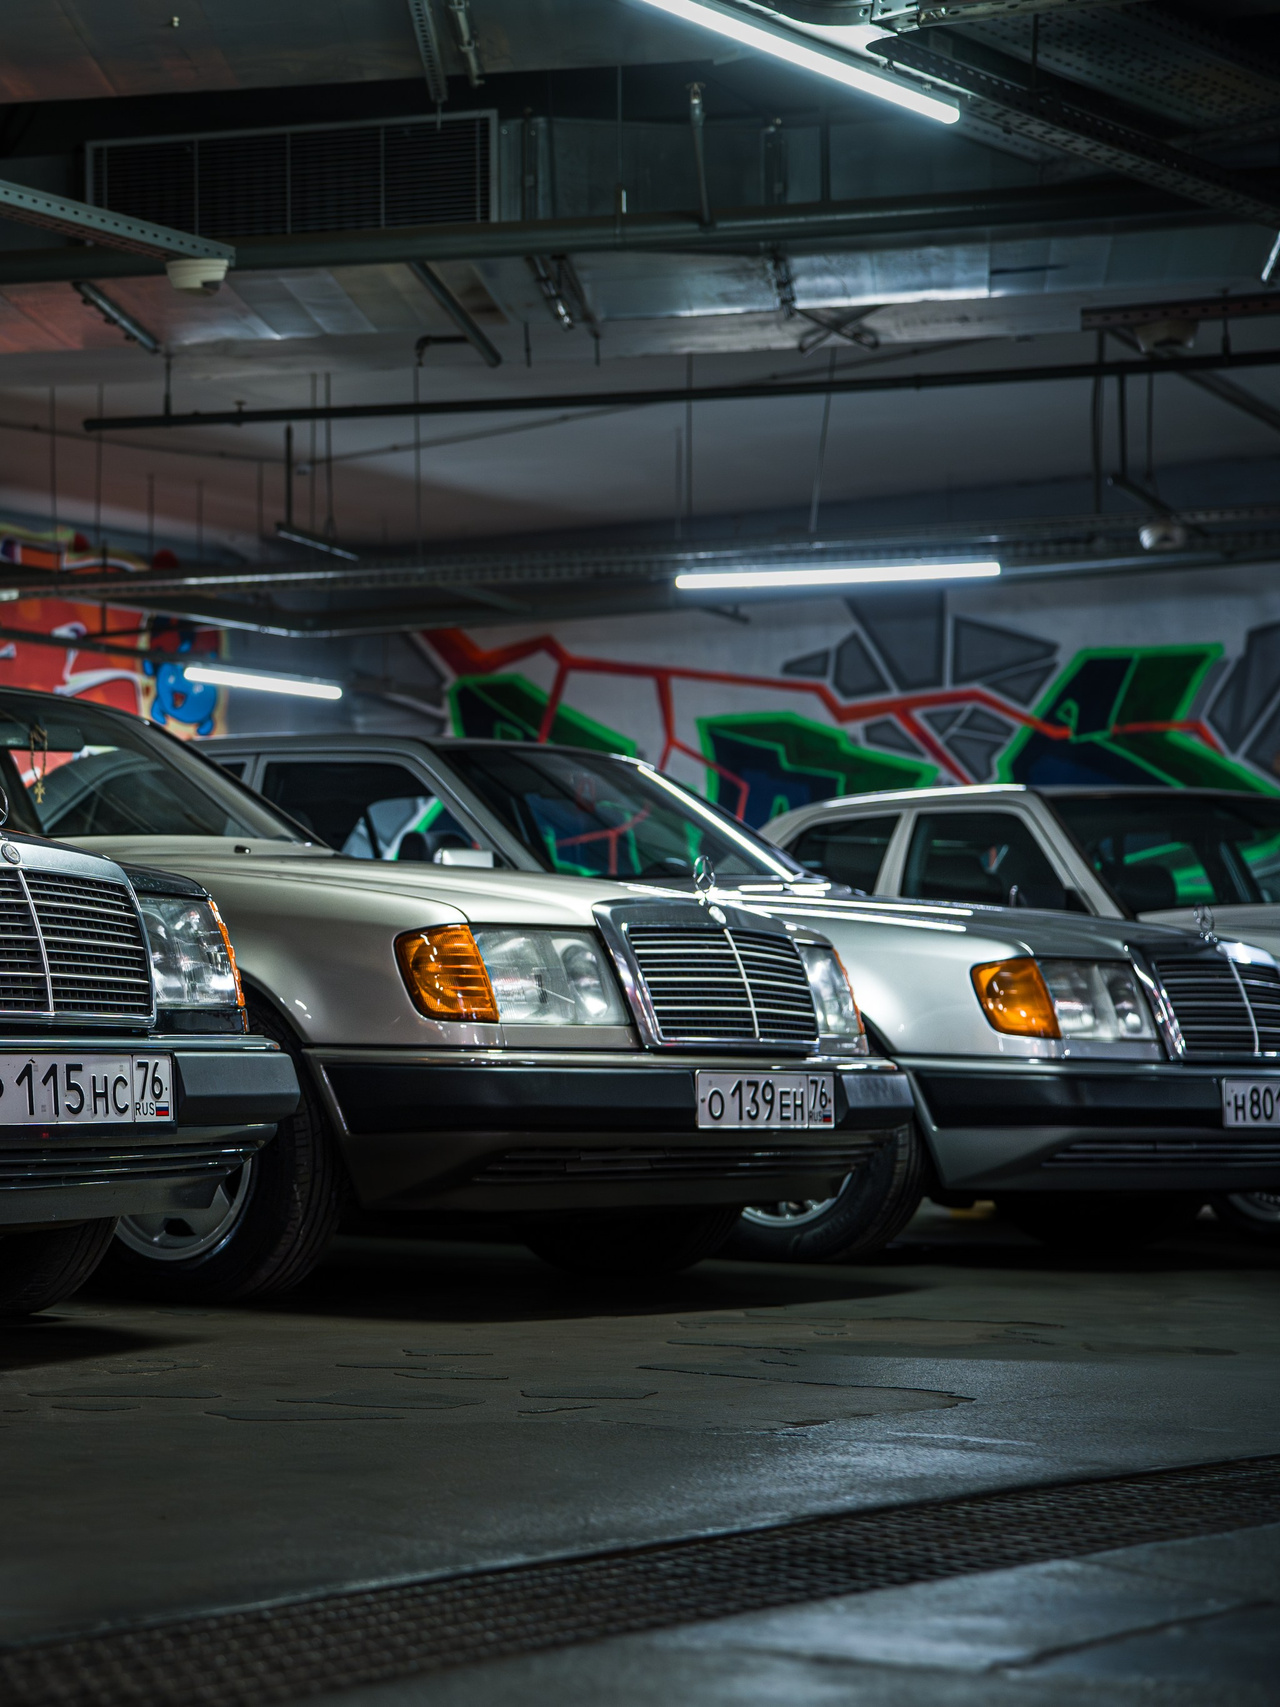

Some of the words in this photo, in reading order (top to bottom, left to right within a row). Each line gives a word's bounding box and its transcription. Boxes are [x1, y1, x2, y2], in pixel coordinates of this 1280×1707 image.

[136, 1060, 164, 1100] 76
[809, 1078, 828, 1110] 76
[135, 1102, 155, 1116] RUS
[809, 1111, 822, 1122] RUS
